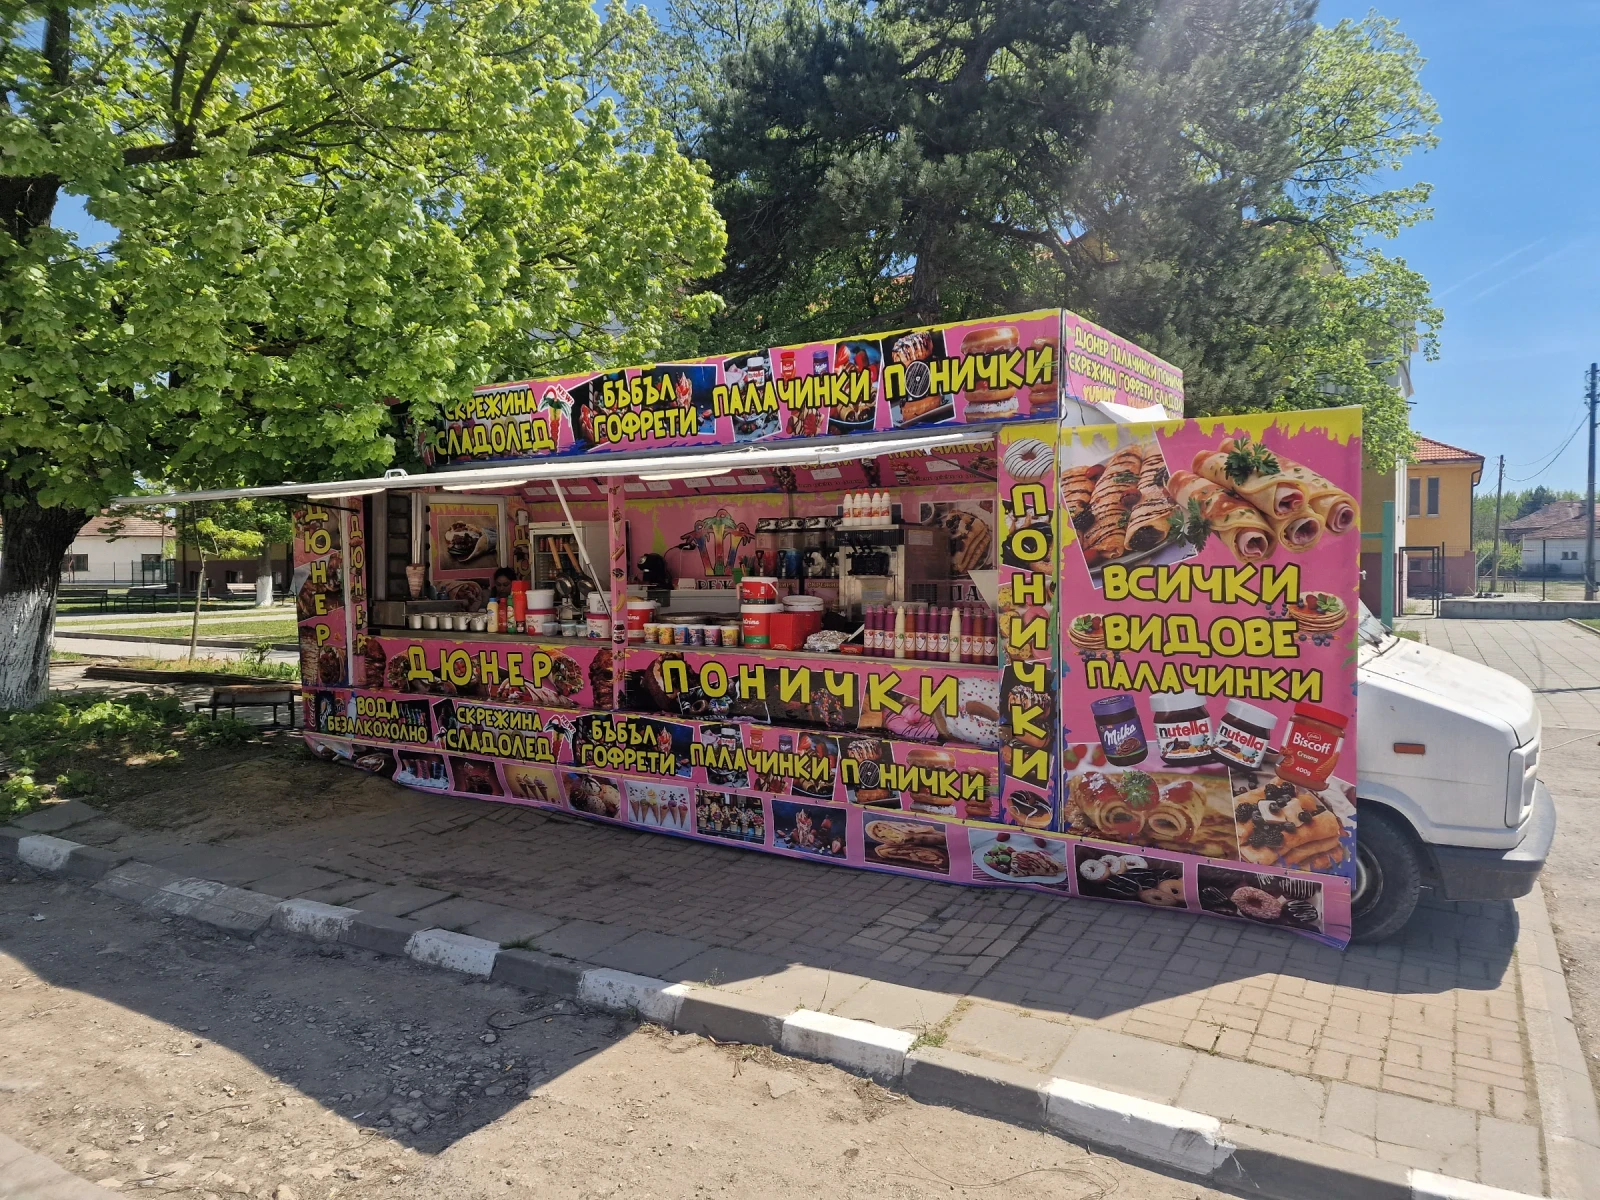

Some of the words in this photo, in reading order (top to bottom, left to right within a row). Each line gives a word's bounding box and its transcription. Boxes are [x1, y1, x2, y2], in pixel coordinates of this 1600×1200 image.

[1075, 325, 1109, 358] ДЮНЕР
[1111, 343, 1157, 380] ПАЛАЧИНКИ
[884, 344, 1053, 401] ПОНИЧКИ
[1069, 350, 1117, 389] СКРЕЖИНА
[1119, 372, 1153, 401] ГОФРЕТИ
[556, 386, 574, 406] NEW!
[603, 374, 676, 409] БЪБЪЛ
[712, 368, 871, 418] ПАЛАЧИНКИ
[435, 419, 554, 456] СЛАДОЛЕД
[593, 407, 698, 443] ГОФРЕТИ
[888, 441, 995, 459] ПАЛЧИНКИ
[350, 515, 364, 655] ДЮНЕР
[1102, 562, 1300, 604] ВСИЧКИ
[1010, 483, 1050, 783] ПОНИЧКИ
[1104, 614, 1299, 658] ВИДОВЕ
[407, 645, 553, 690] ДЮНЕР
[1086, 659, 1322, 701] ПАЛАЧИНКИ
[661, 659, 960, 717] ПОНИЧКИ
[356, 696, 400, 719] ВОДА
[457, 707, 543, 731] СКРЕЖИНА
[327, 715, 428, 744] БЕЗАЛКОХОЛНО
[447, 729, 554, 763] СЛАДОЛЕД
[592, 720, 657, 746] БЪБЪЛ
[1104, 724, 1136, 746] Milka
[1159, 721, 1209, 737] nutella
[1220, 725, 1264, 751] nutella
[1292, 732, 1332, 754] Biscoff
[581, 744, 676, 775] ГОФРЕТИ
[690, 743, 828, 781] ПАЛАЧИНКИ
[1296, 766, 1311, 776] 400g
[1297, 751, 1318, 763] Creamy
[841, 759, 985, 801] ПОНИЧКИ
